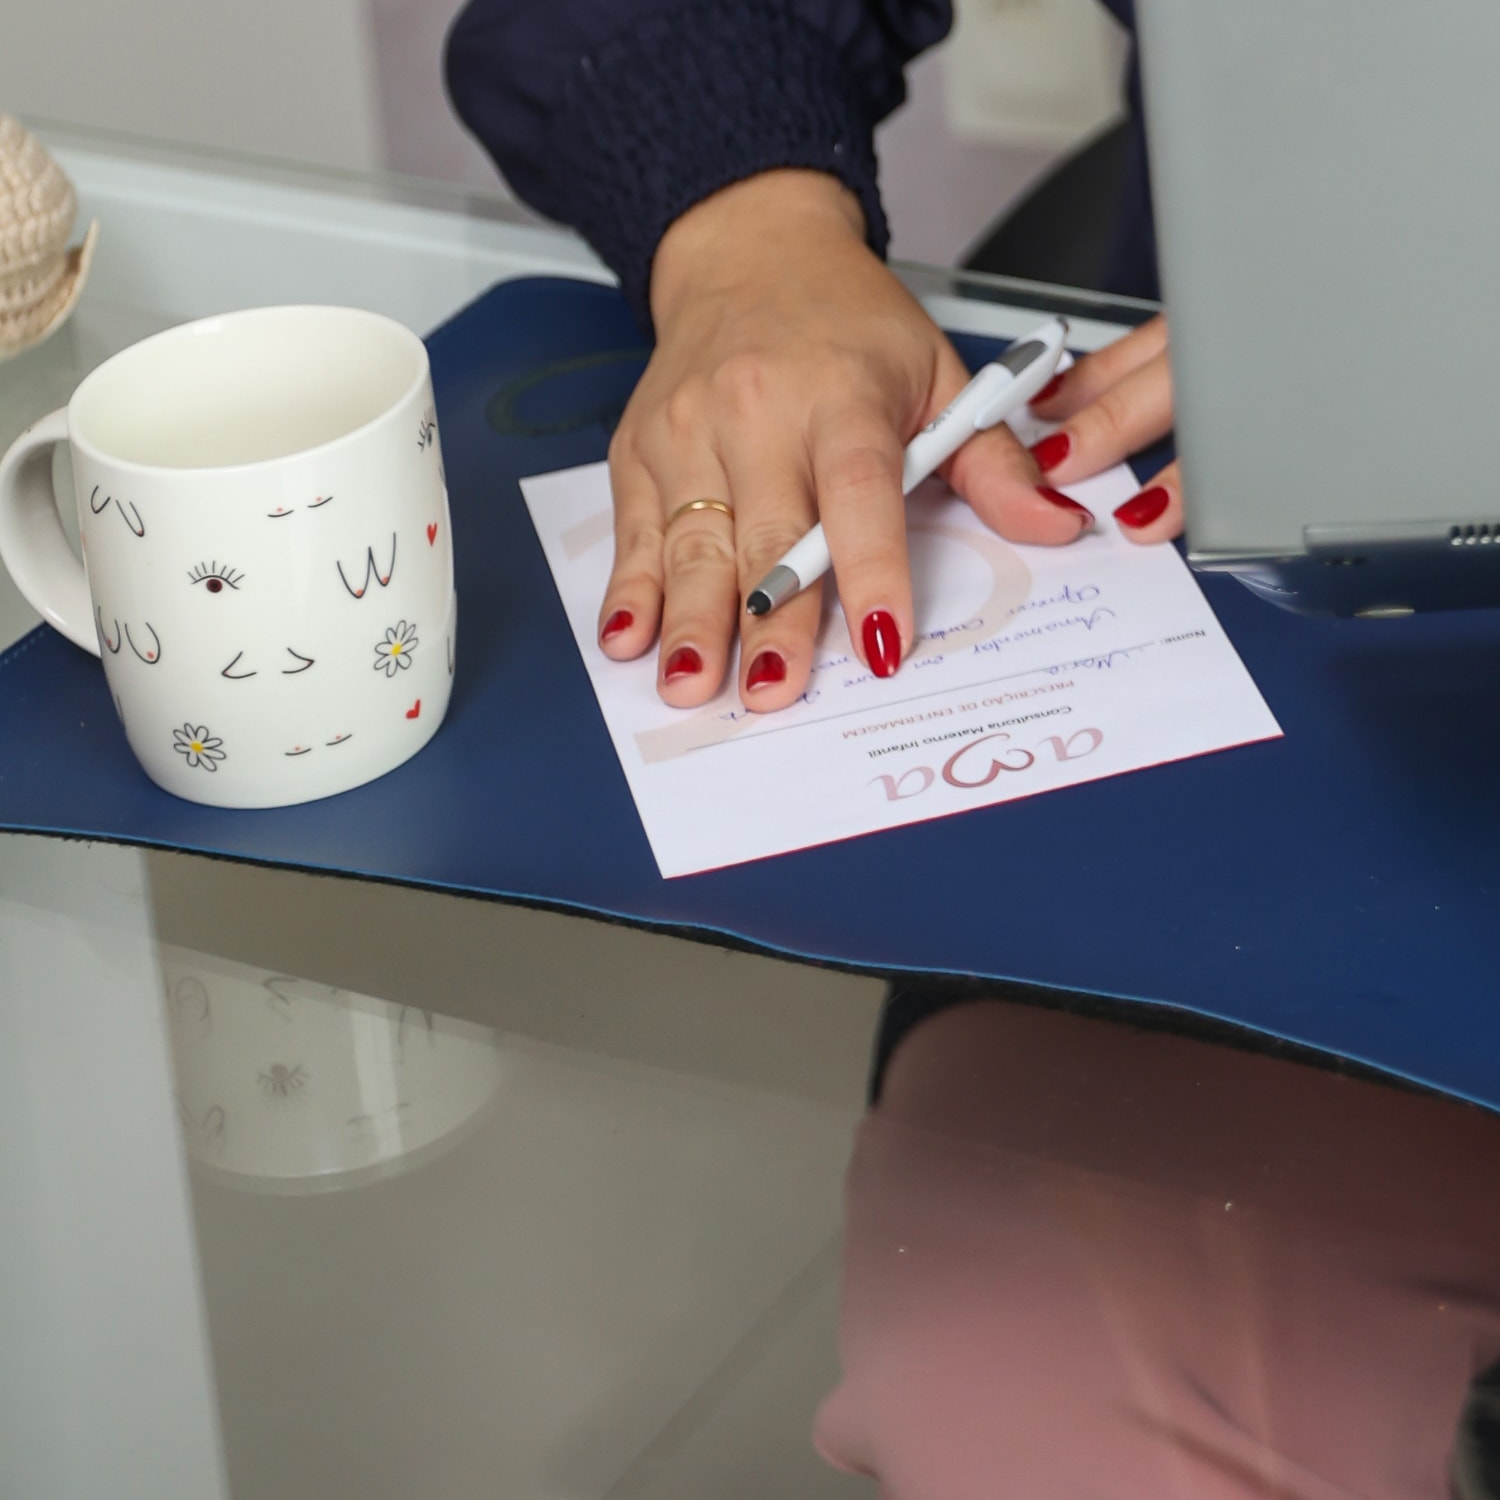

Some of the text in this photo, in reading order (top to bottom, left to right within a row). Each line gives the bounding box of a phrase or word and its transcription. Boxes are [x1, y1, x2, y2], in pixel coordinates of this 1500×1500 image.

[1043, 651, 1131, 676] Maria
[841, 679, 1076, 740] PRESCRIÇÃO DE ENFERMAGEM
[867, 705, 1073, 759] Consultoria Materno Infantil
